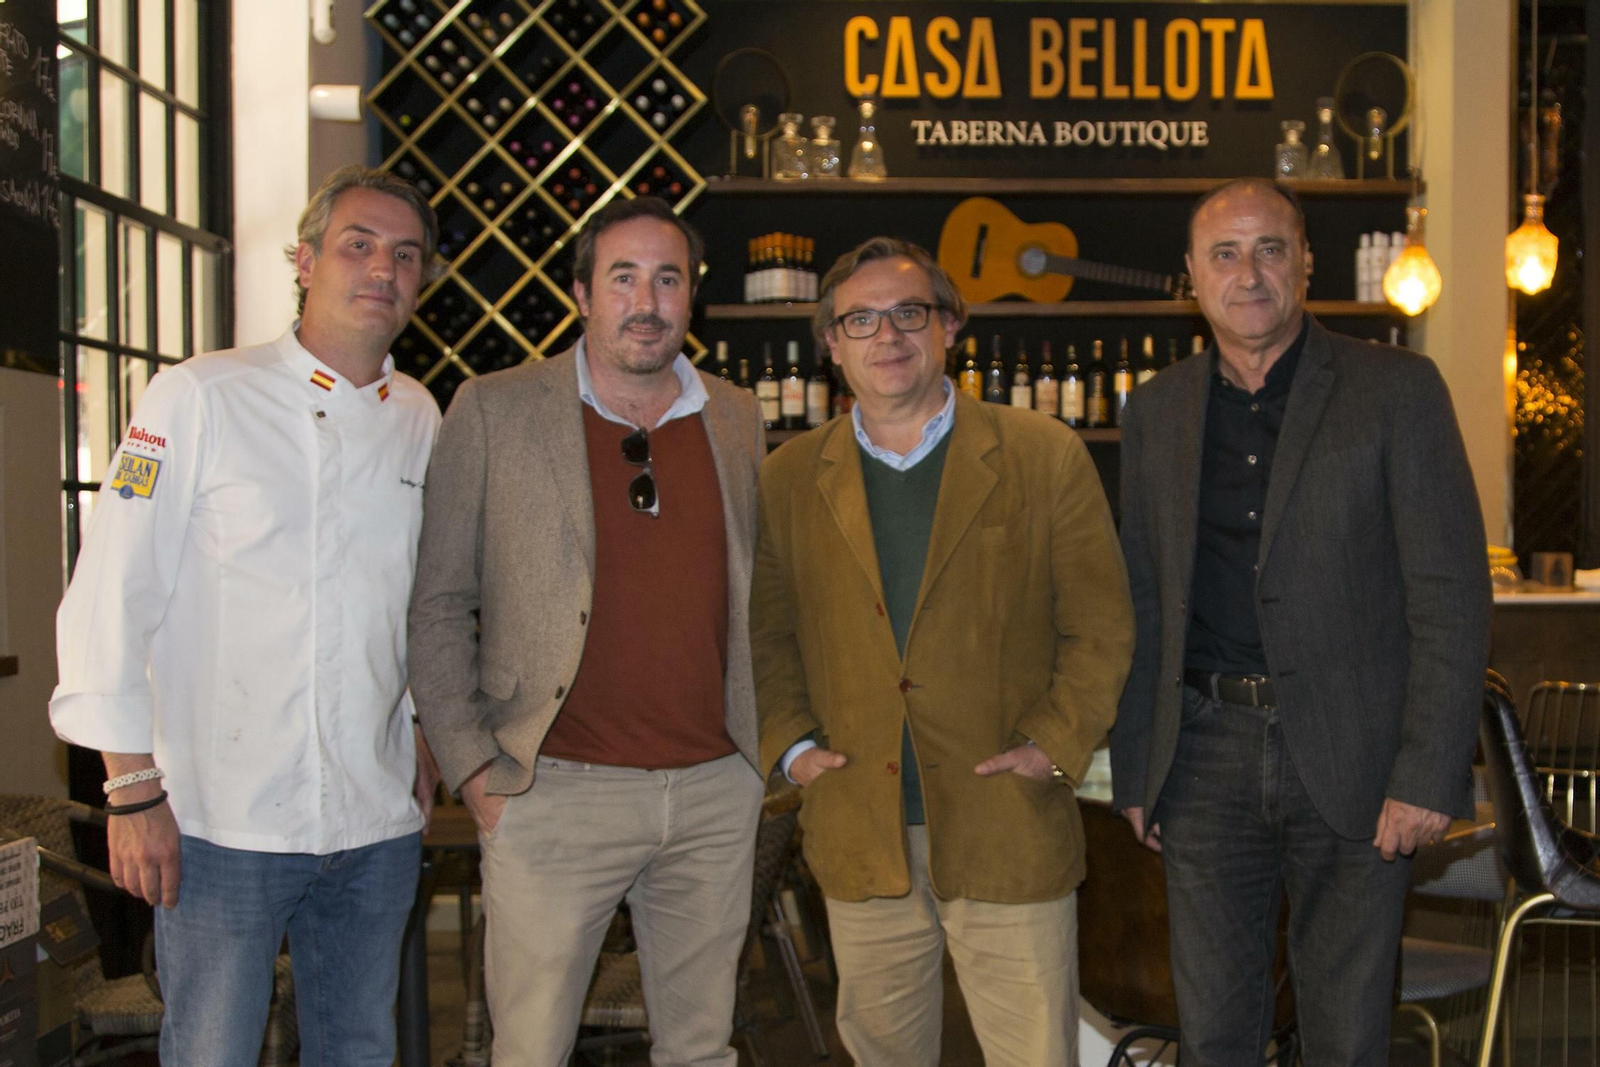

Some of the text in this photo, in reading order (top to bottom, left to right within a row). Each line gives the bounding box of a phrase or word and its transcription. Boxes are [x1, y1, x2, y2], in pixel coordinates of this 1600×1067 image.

[843, 15, 1275, 101] CASA BELLOTA
[910, 119, 1209, 151] TABERNA BOUTIQUE
